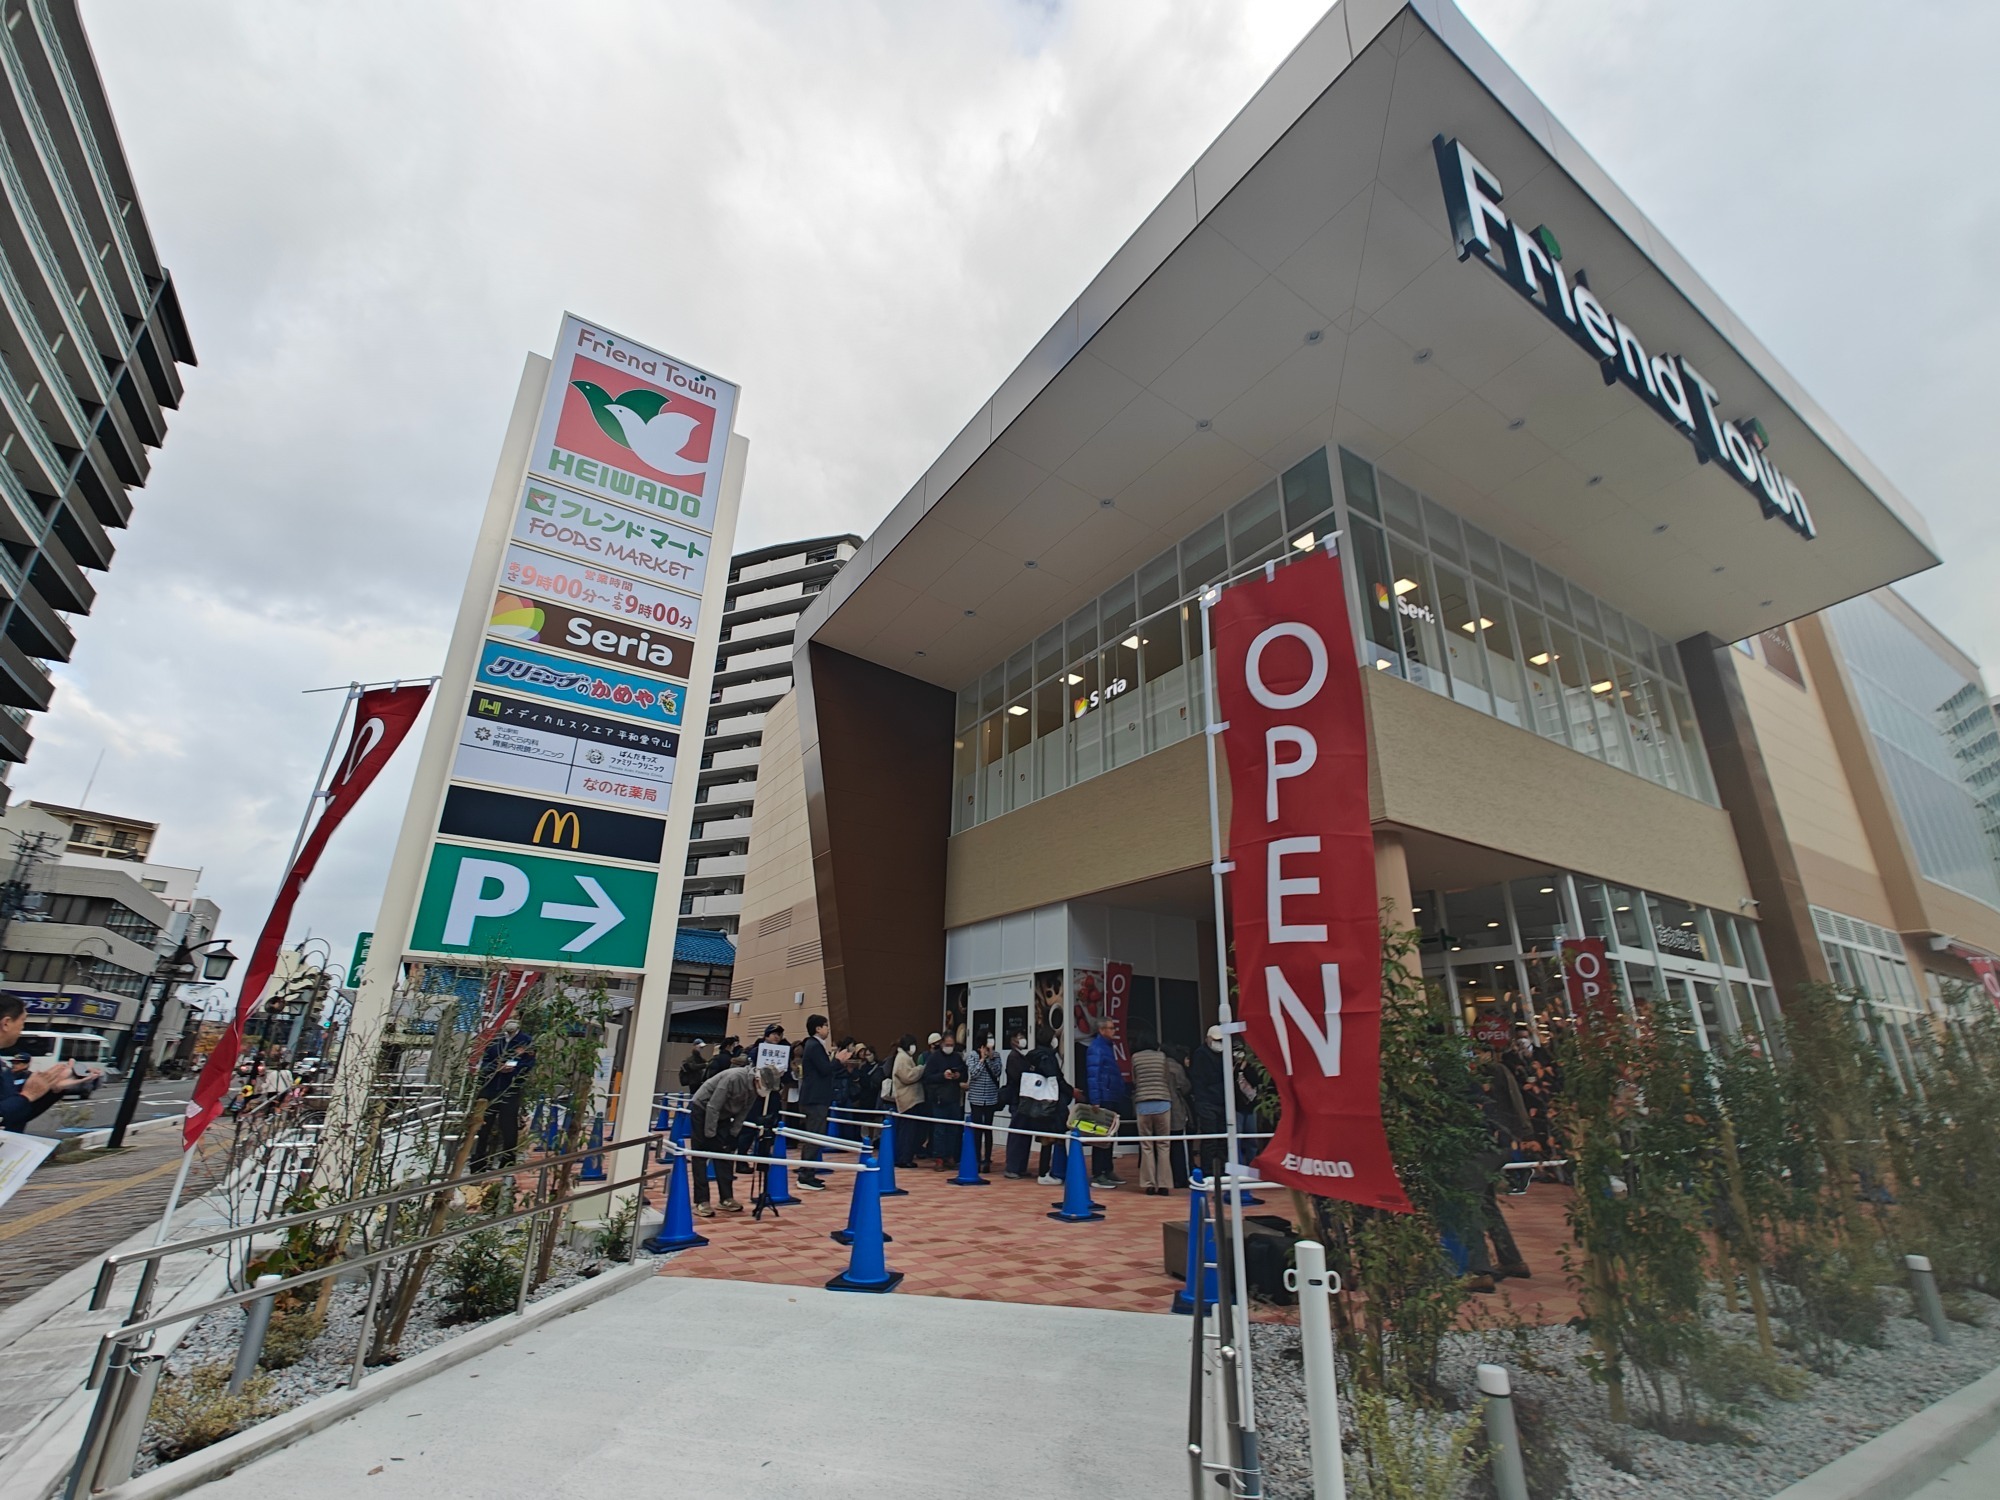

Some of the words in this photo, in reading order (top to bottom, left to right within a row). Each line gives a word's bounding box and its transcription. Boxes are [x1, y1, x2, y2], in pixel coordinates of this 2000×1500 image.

[577, 328, 657, 376] Friend
[662, 361, 717, 400] Town
[1446, 137, 1697, 431] Friend
[1680, 356, 1817, 539] Town
[548, 448, 701, 518] HEIWADO
[529, 517, 602, 552] FOODS
[605, 542, 694, 580] MARKET
[560, 499, 704, 558] フレンドマート
[584, 569, 633, 592] 営業時間
[565, 617, 673, 666] Seria
[1090, 678, 1127, 708] Sria
[582, 777, 657, 802] なの花薬局
[610, 756, 665, 773] ファミリークリニック
[1244, 621, 1341, 1078] OPEN
[441, 857, 530, 946] P
[1281, 1152, 1355, 1178] EIWADO
